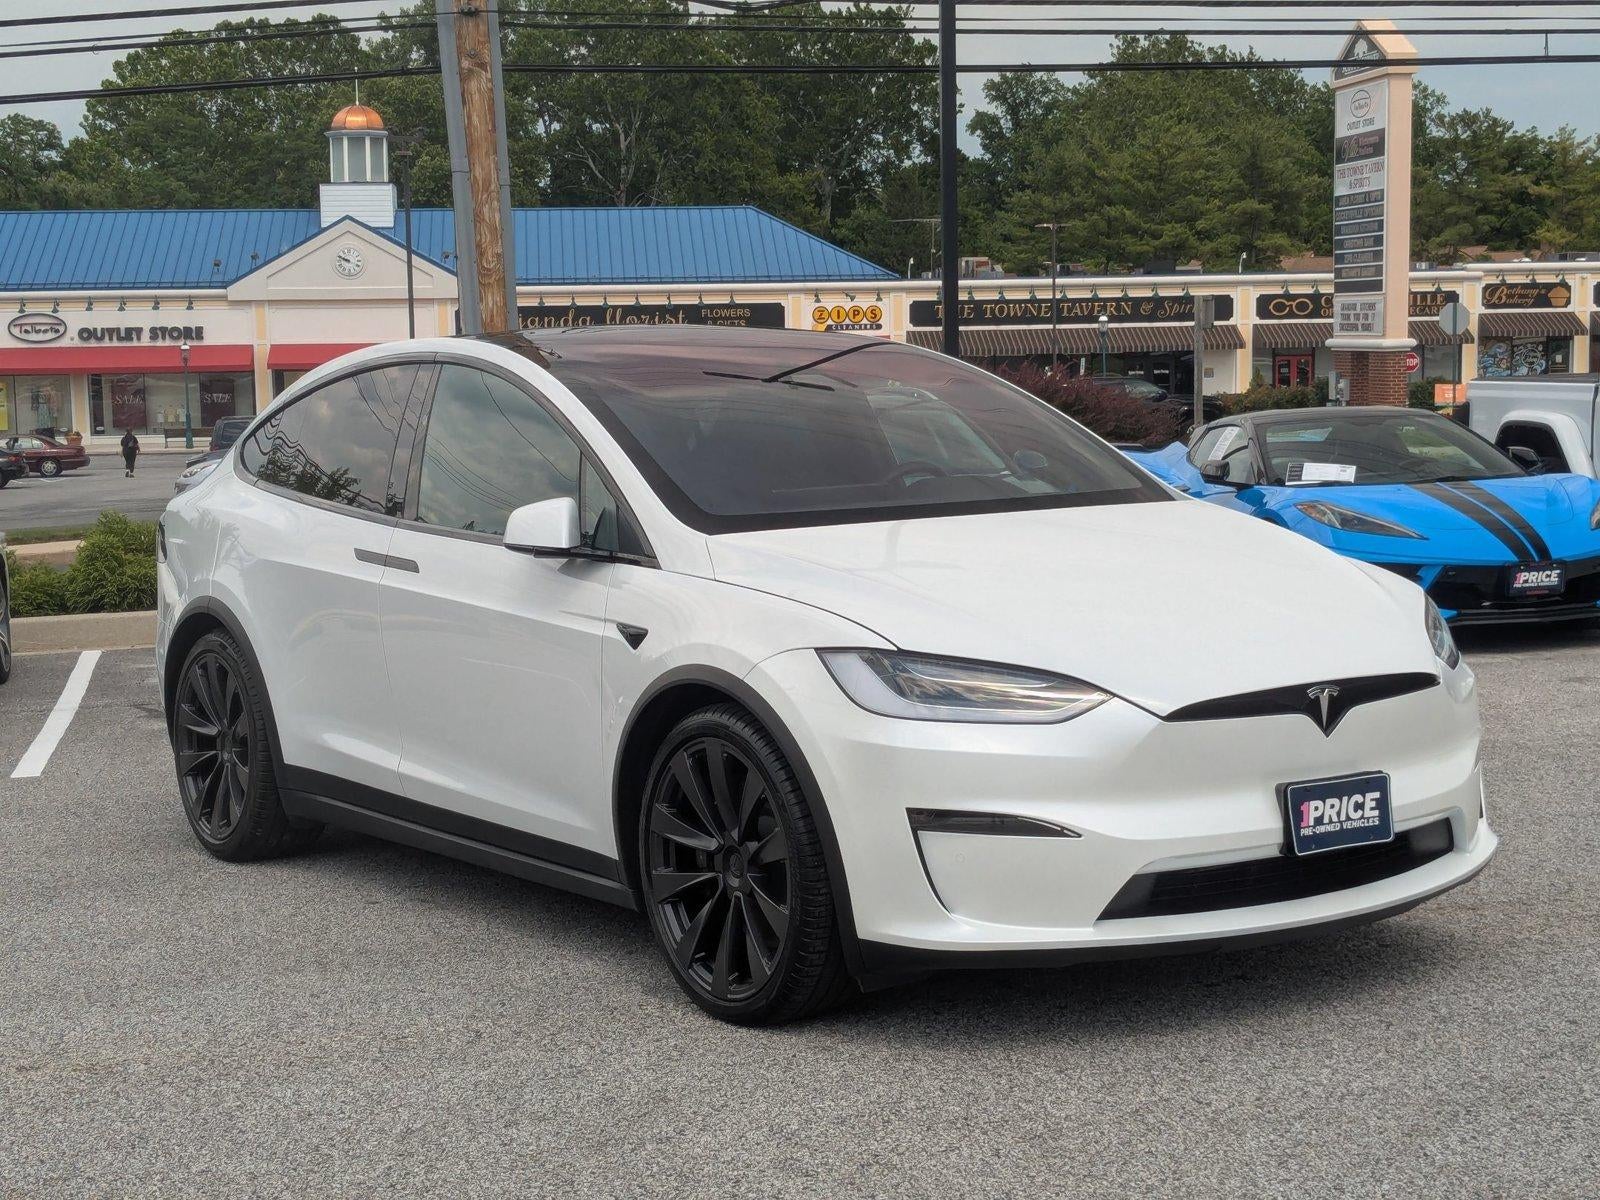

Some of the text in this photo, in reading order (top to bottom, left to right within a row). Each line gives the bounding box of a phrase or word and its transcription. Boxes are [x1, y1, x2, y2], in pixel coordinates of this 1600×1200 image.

[701, 308, 752, 318] FLOWERS
[815, 307, 880, 321] ZIPS
[982, 302, 1053, 318] TOWNE
[1060, 301, 1133, 317] TAVERN
[1140, 300, 1154, 315] &
[77, 326, 204, 342] OUTLET STORE
[1514, 570, 1561, 585] 1PRICE
[1300, 791, 1380, 828] 1PRICE
[1300, 817, 1379, 837] PRE-OWNED VEHICLES
